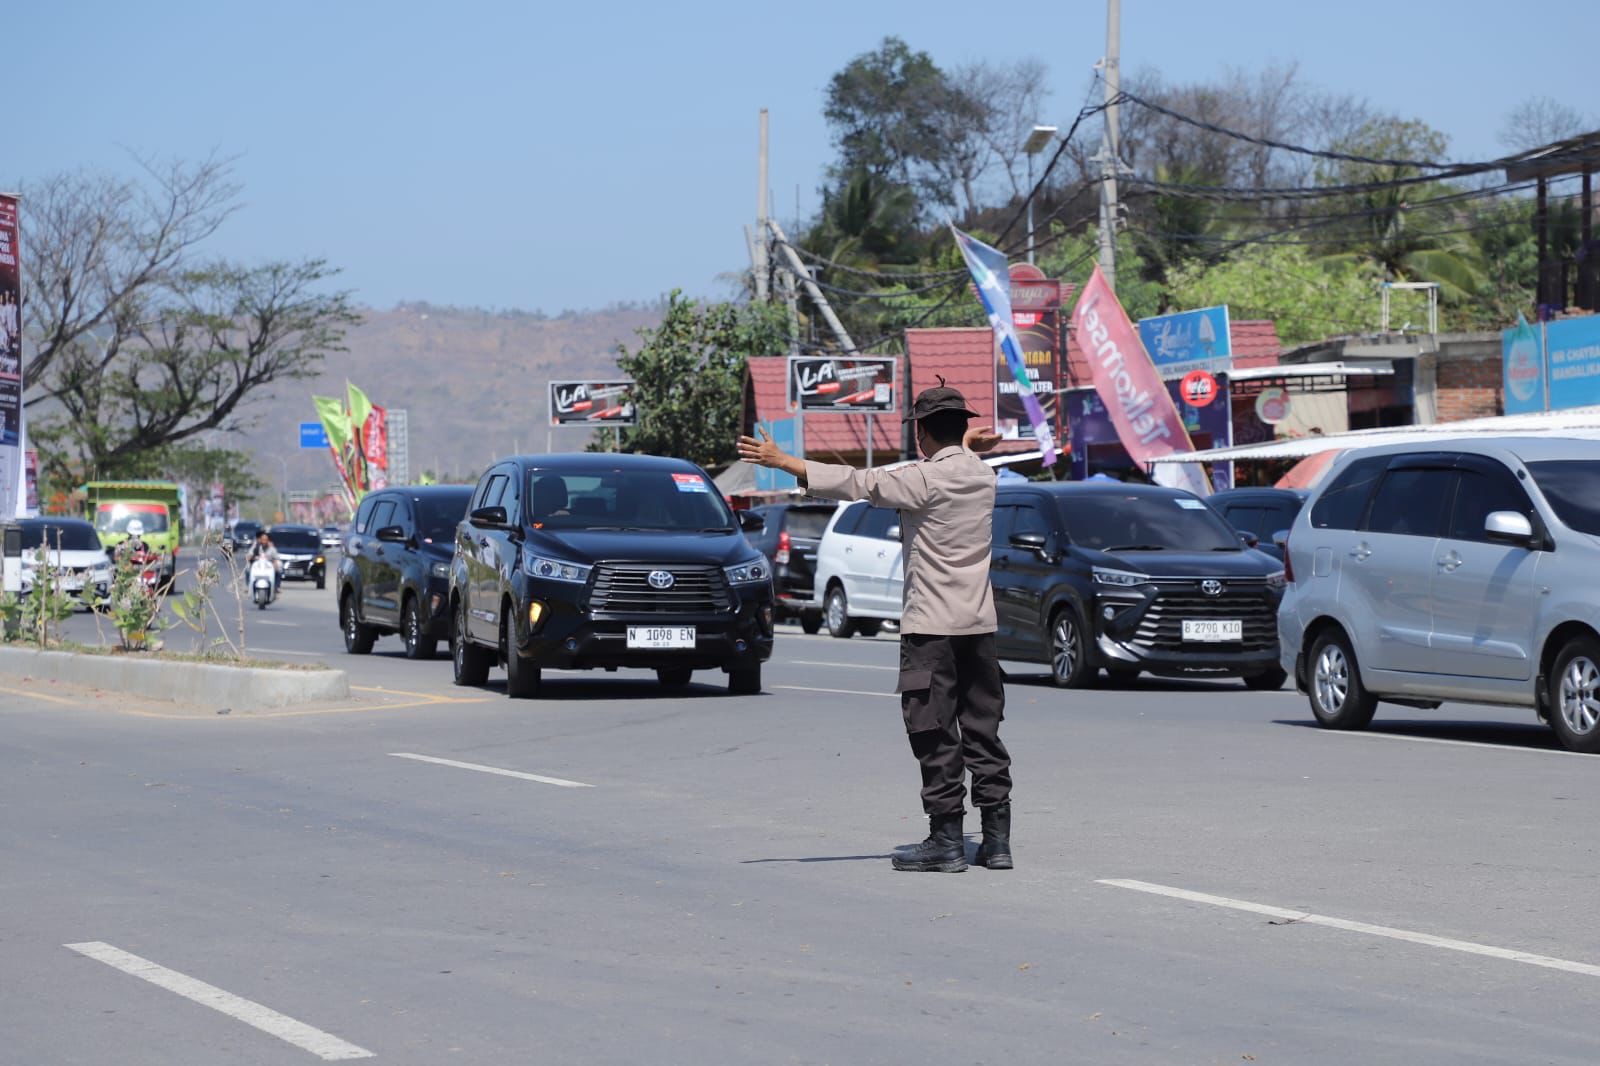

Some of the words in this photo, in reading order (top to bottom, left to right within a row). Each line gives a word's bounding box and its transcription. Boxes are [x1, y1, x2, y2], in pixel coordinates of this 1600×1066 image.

[802, 362, 833, 388] LA
[560, 384, 586, 407] LA
[629, 629, 636, 641] N
[646, 629, 673, 641] 1098
[680, 629, 694, 641] EN
[1184, 623, 1191, 633] B
[1195, 623, 1218, 633] 2790
